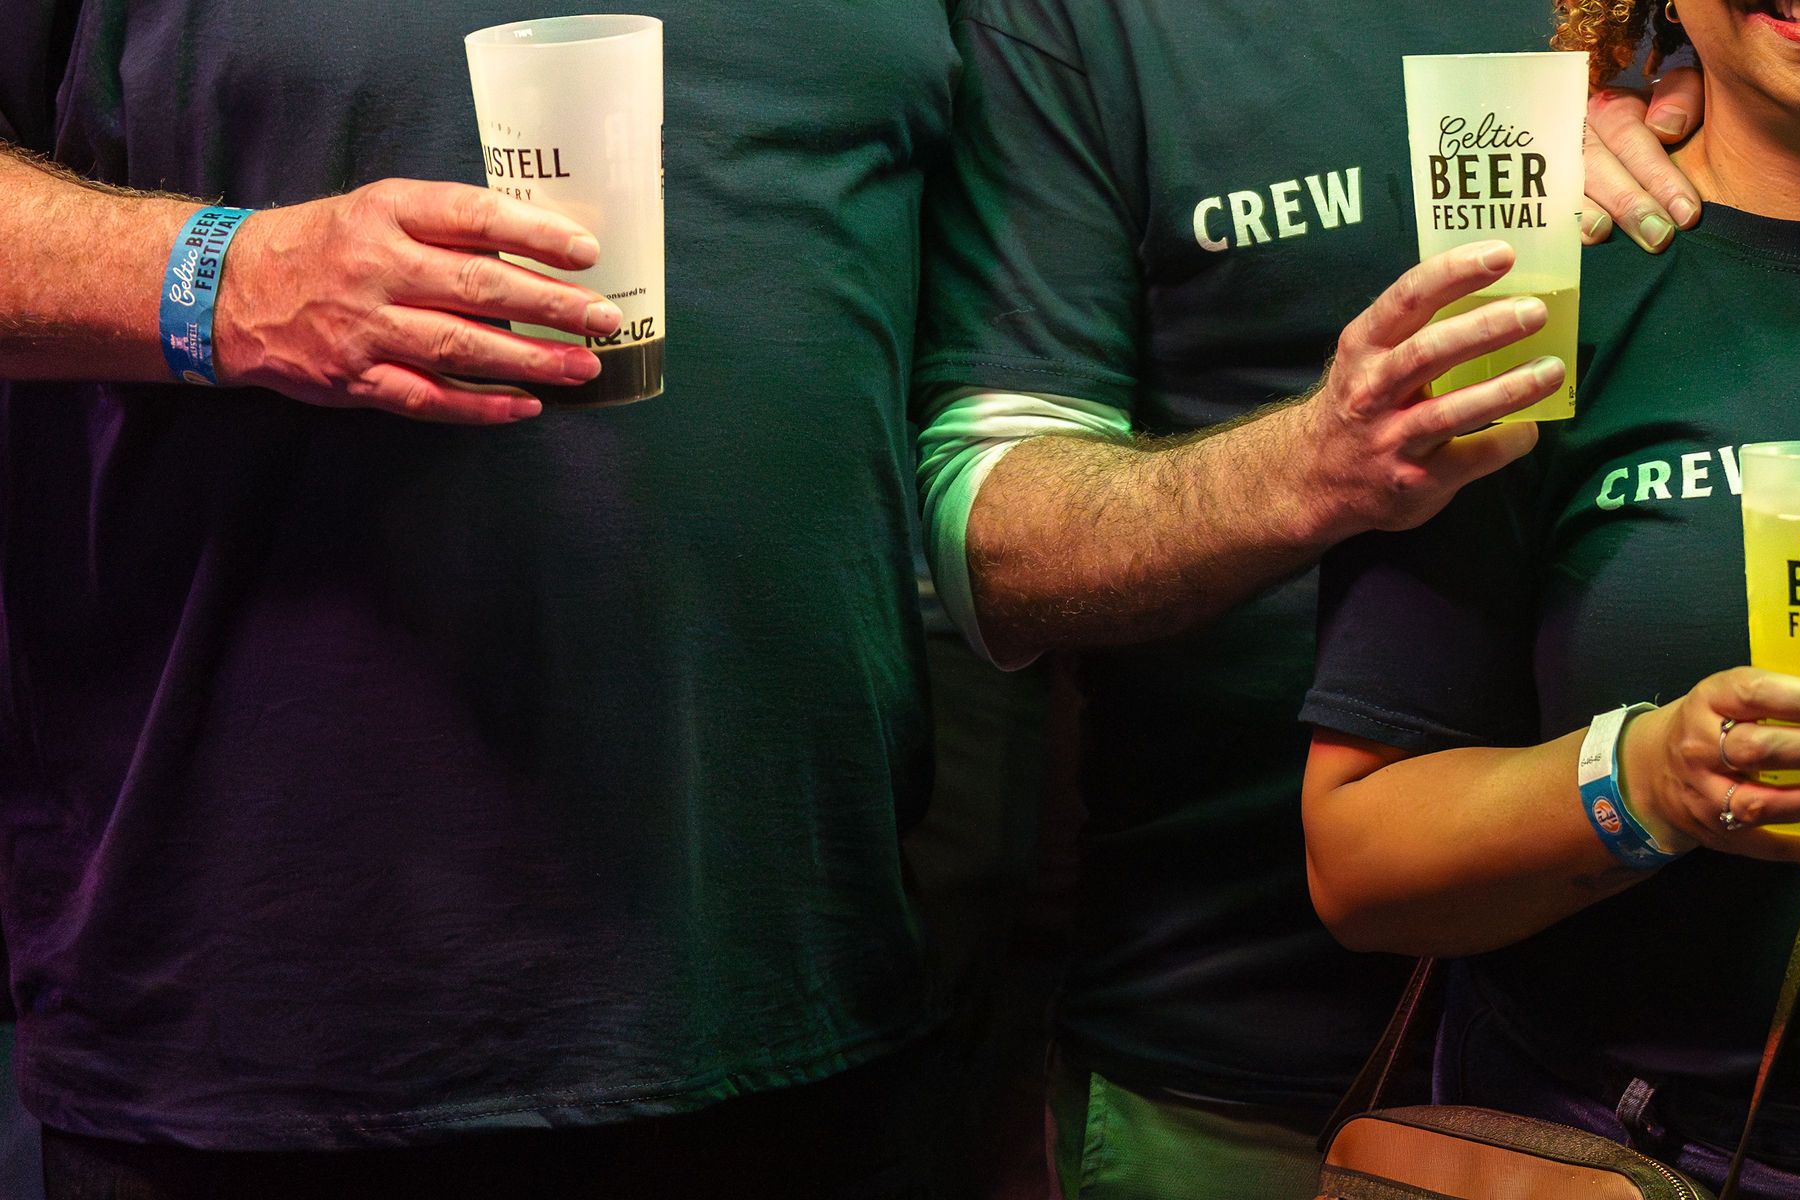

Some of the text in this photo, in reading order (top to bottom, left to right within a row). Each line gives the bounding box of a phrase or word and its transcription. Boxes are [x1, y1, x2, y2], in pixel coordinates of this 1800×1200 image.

[1438, 111, 1535, 161] Celtic
[483, 145, 571, 179] USTELL
[1428, 152, 1548, 201] BEER
[1192, 166, 1363, 252] CREW
[1432, 202, 1548, 231] FESTIVAL
[168, 211, 223, 307] Celtic BEER
[194, 213, 242, 291] FESTIVAL
